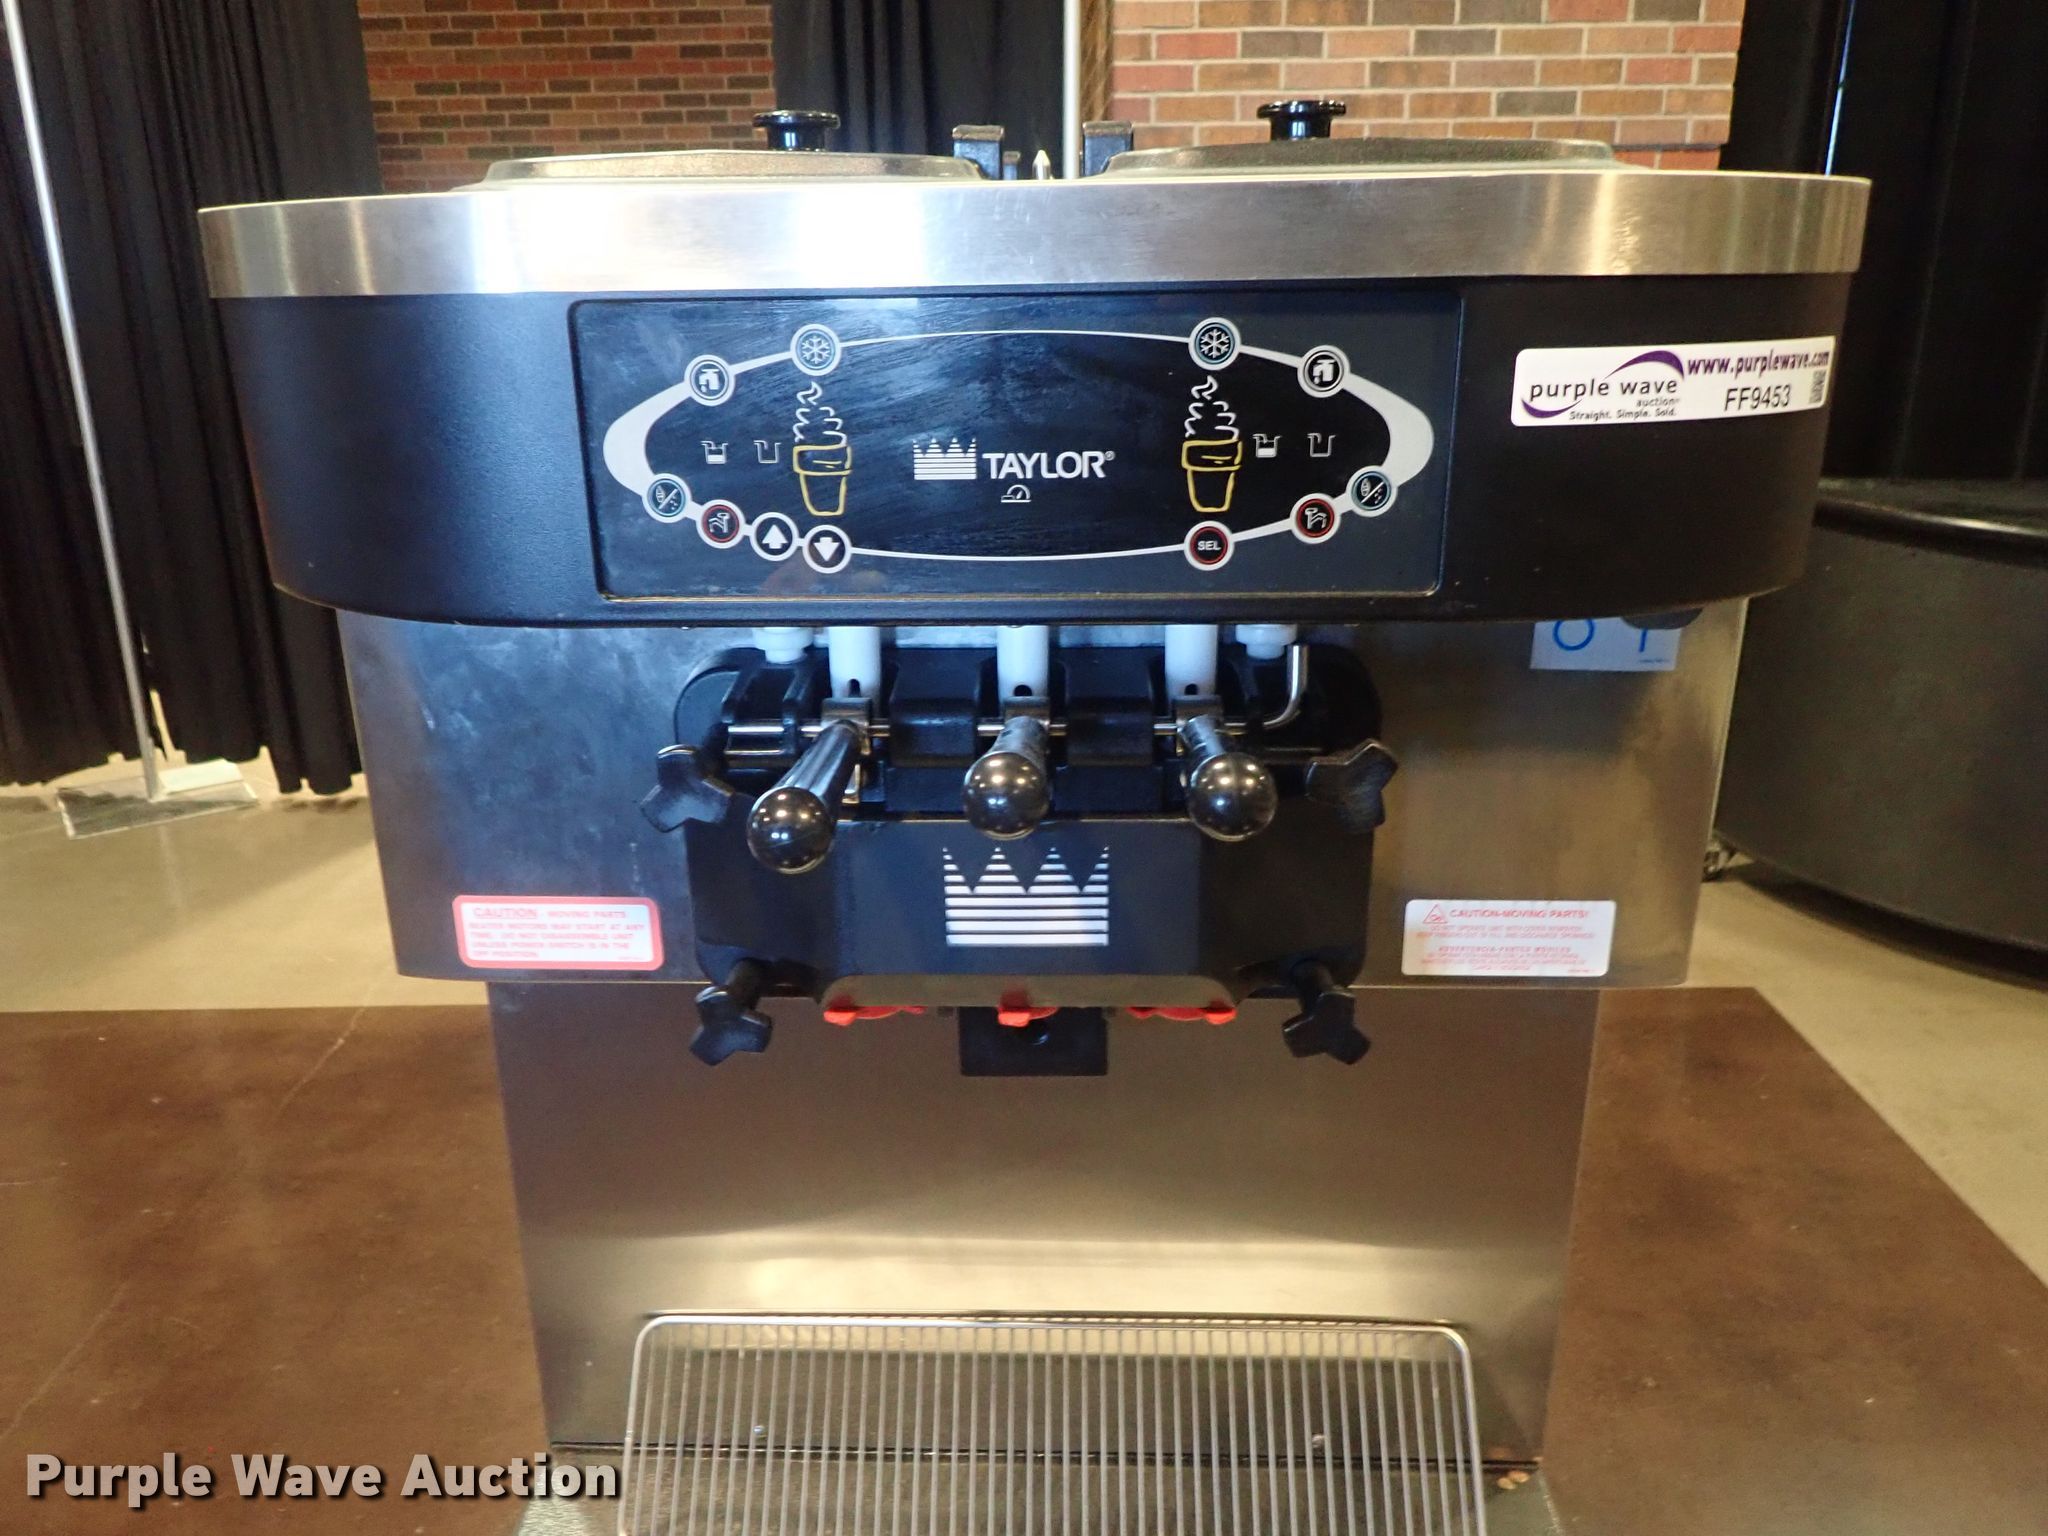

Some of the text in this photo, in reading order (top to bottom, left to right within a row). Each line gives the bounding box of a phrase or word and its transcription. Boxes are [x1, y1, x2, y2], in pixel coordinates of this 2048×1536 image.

[1687, 349, 1829, 379] www.purplewave.com
[1530, 378, 1678, 402] purple wave
[1724, 384, 1792, 411] FF9453
[1569, 408, 1677, 422] Straight. Simple. Sold.
[1197, 540, 1221, 551] SEL
[472, 907, 538, 918] CAUTION
